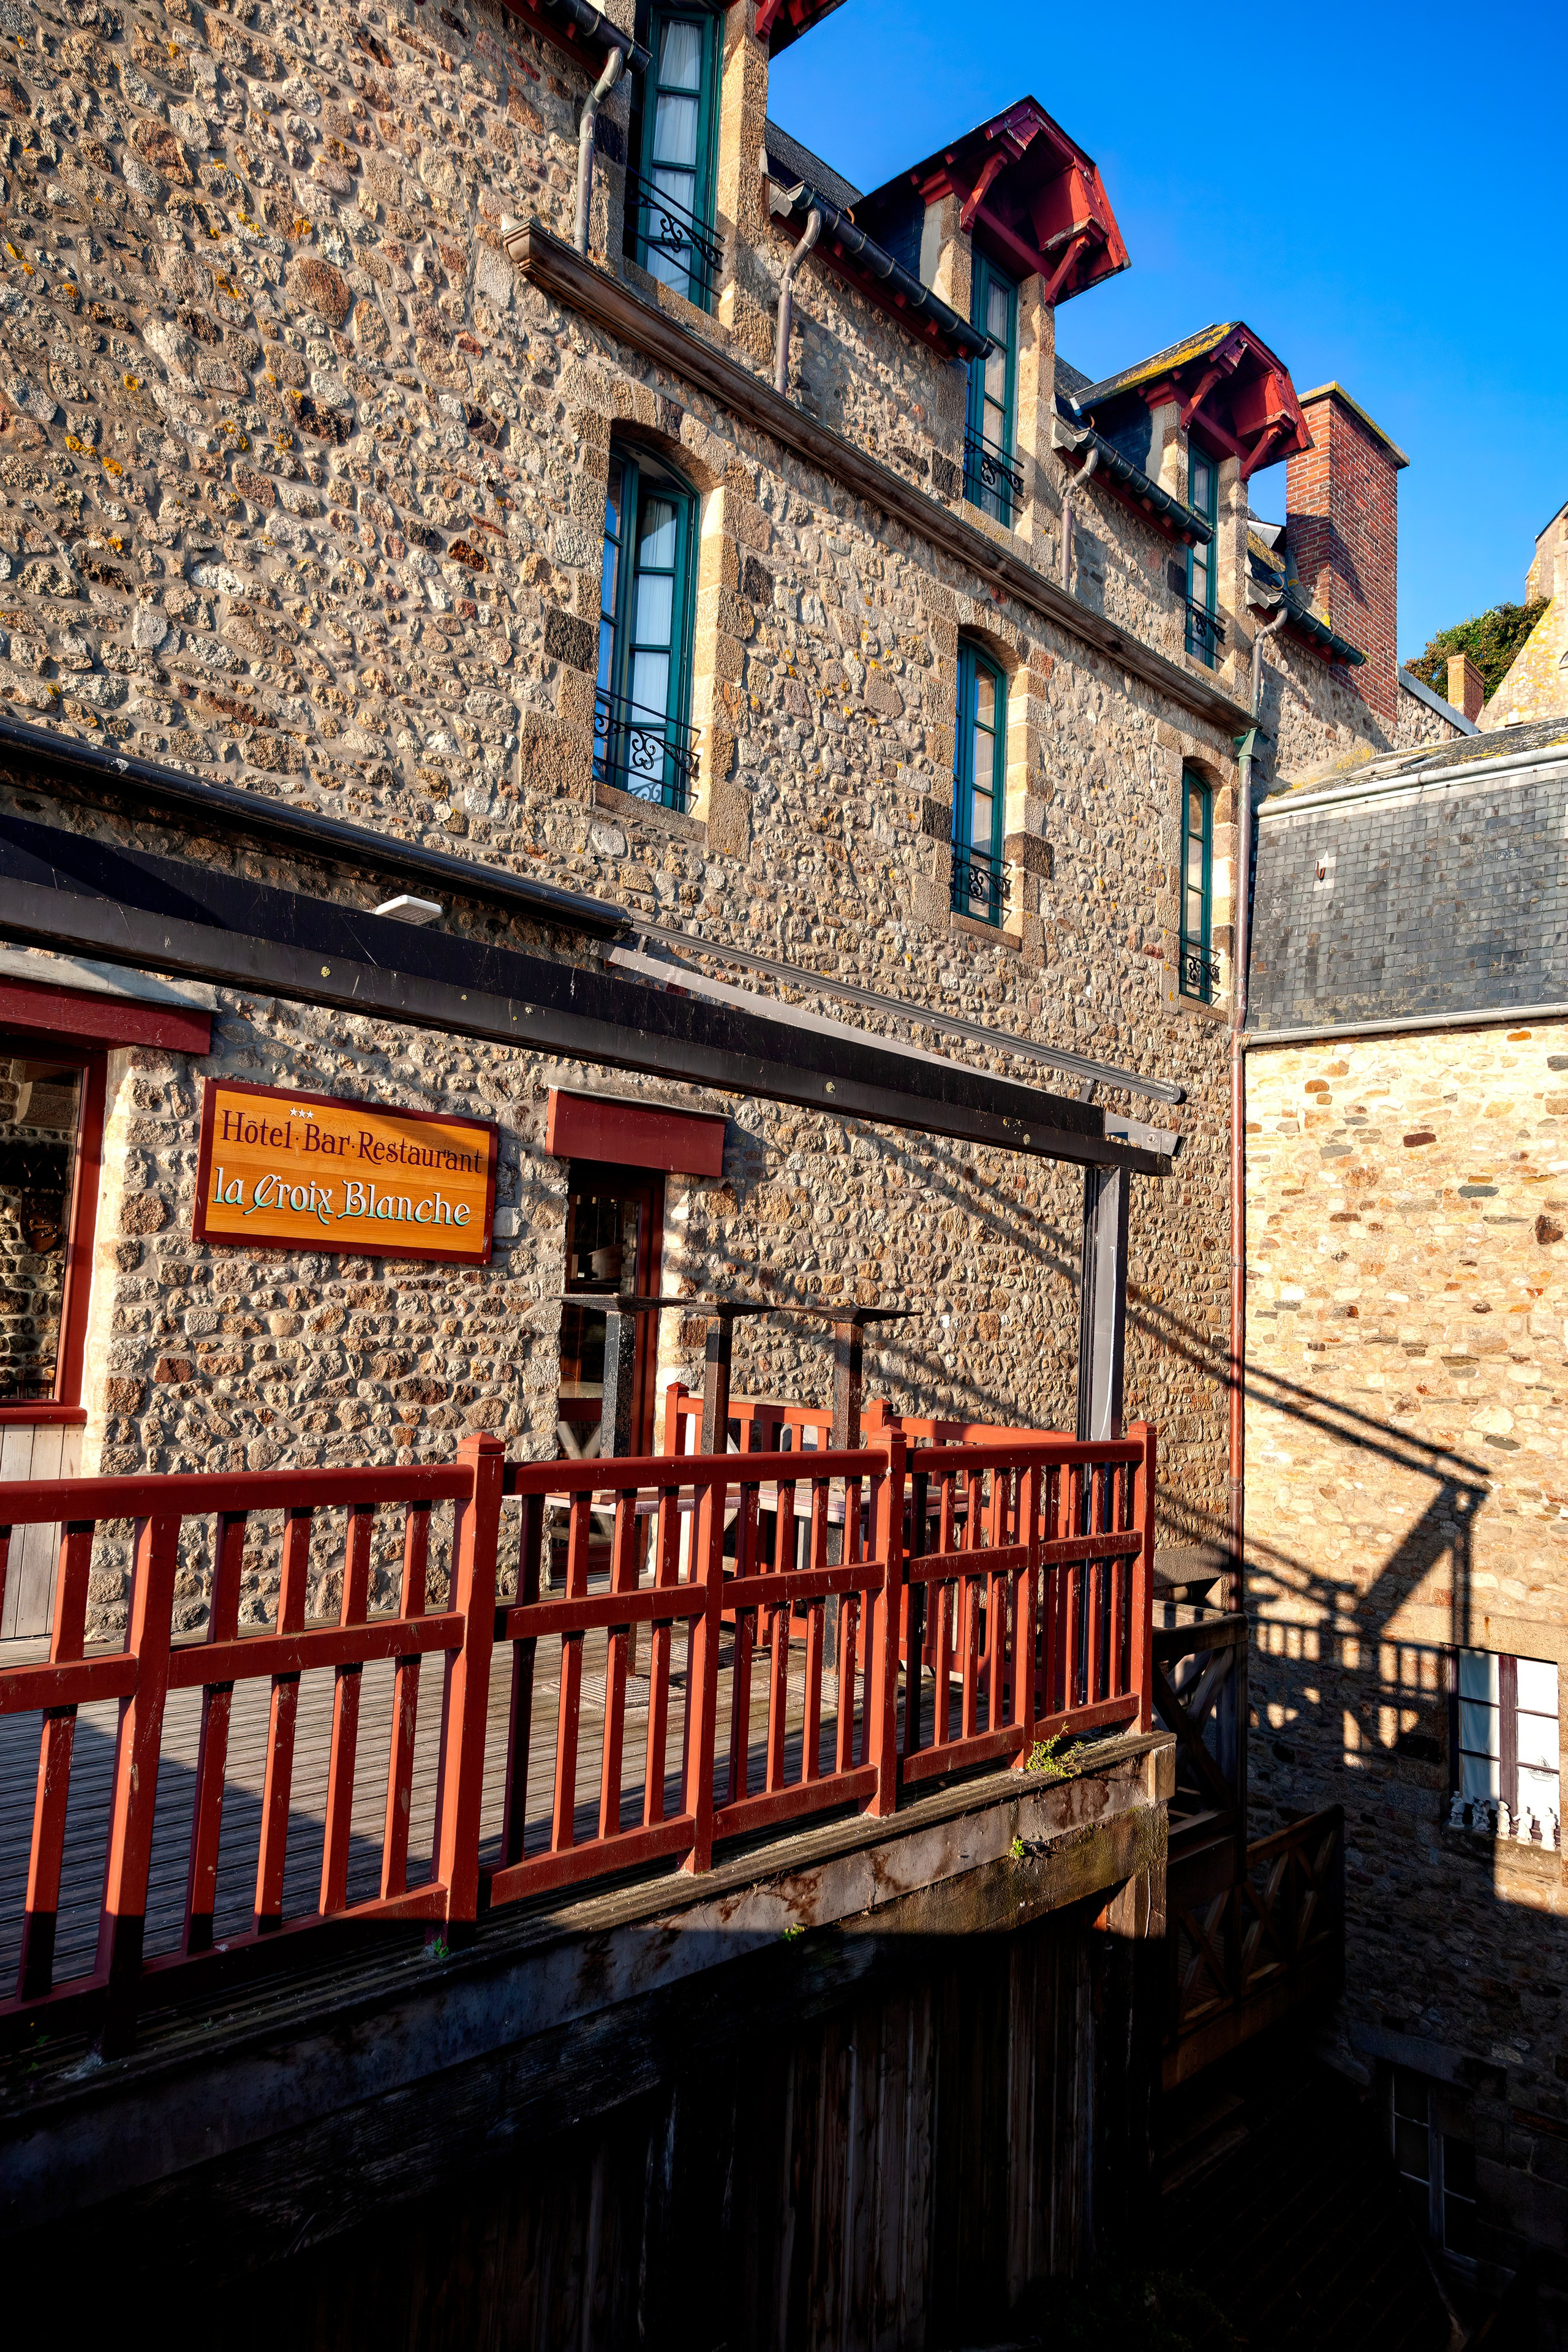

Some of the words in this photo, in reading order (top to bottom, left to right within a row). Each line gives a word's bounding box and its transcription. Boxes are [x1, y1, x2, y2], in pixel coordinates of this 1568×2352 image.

[220, 1109, 293, 1149] Hôtel
[303, 1123, 350, 1156] Bar
[357, 1131, 483, 1174] Restaurant
[212, 1167, 244, 1205] la
[243, 1174, 334, 1225] Croix
[336, 1180, 471, 1227] Blanche
